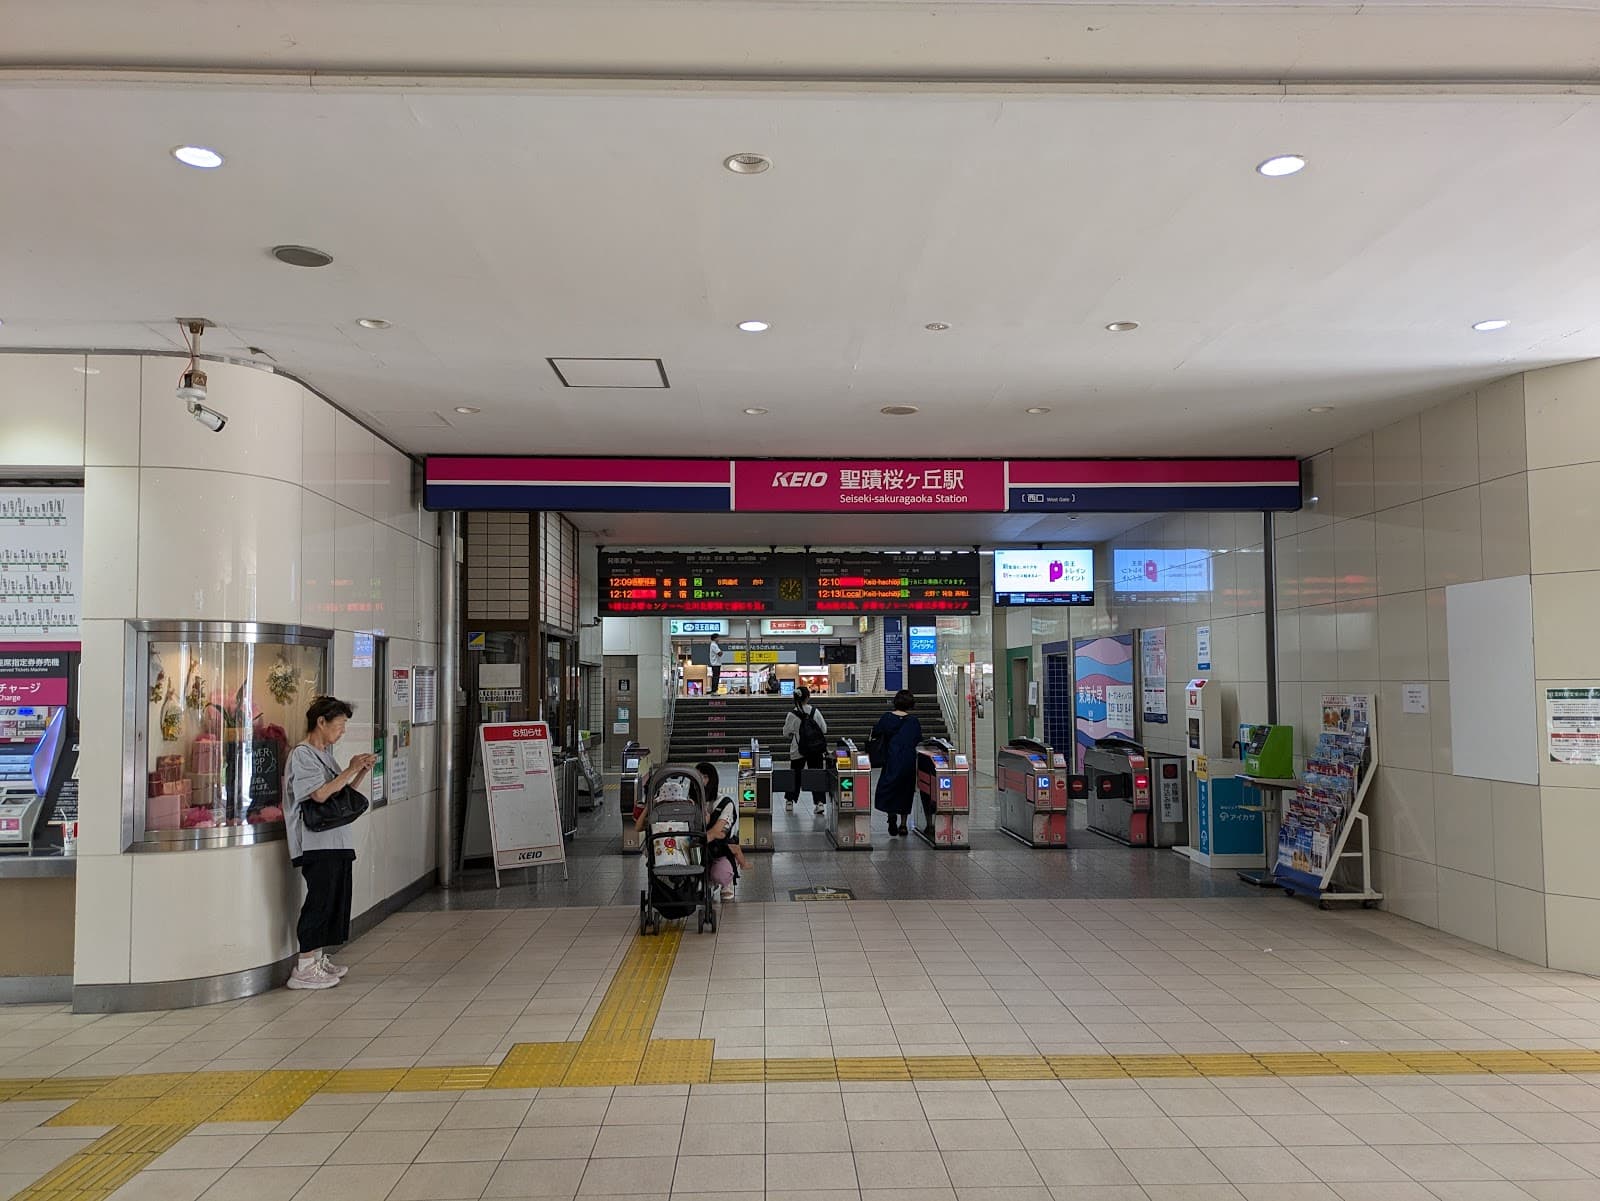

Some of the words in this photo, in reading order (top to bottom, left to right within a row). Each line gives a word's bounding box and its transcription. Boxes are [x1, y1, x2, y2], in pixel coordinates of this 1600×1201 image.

[771, 471, 828, 486] KEIO
[839, 492, 932, 505] Seiseki-sakuragaoka
[936, 492, 968, 503] Station
[610, 578, 632, 587] 12:09
[818, 578, 840, 586] 12:10
[610, 590, 632, 599] 12:12
[818, 590, 840, 598] 12:13
[1078, 685, 1103, 704] 東海大学
[512, 727, 542, 737] お知らせ
[940, 778, 951, 789] IC
[1038, 778, 1049, 788] IC
[518, 851, 543, 860] KEIO
